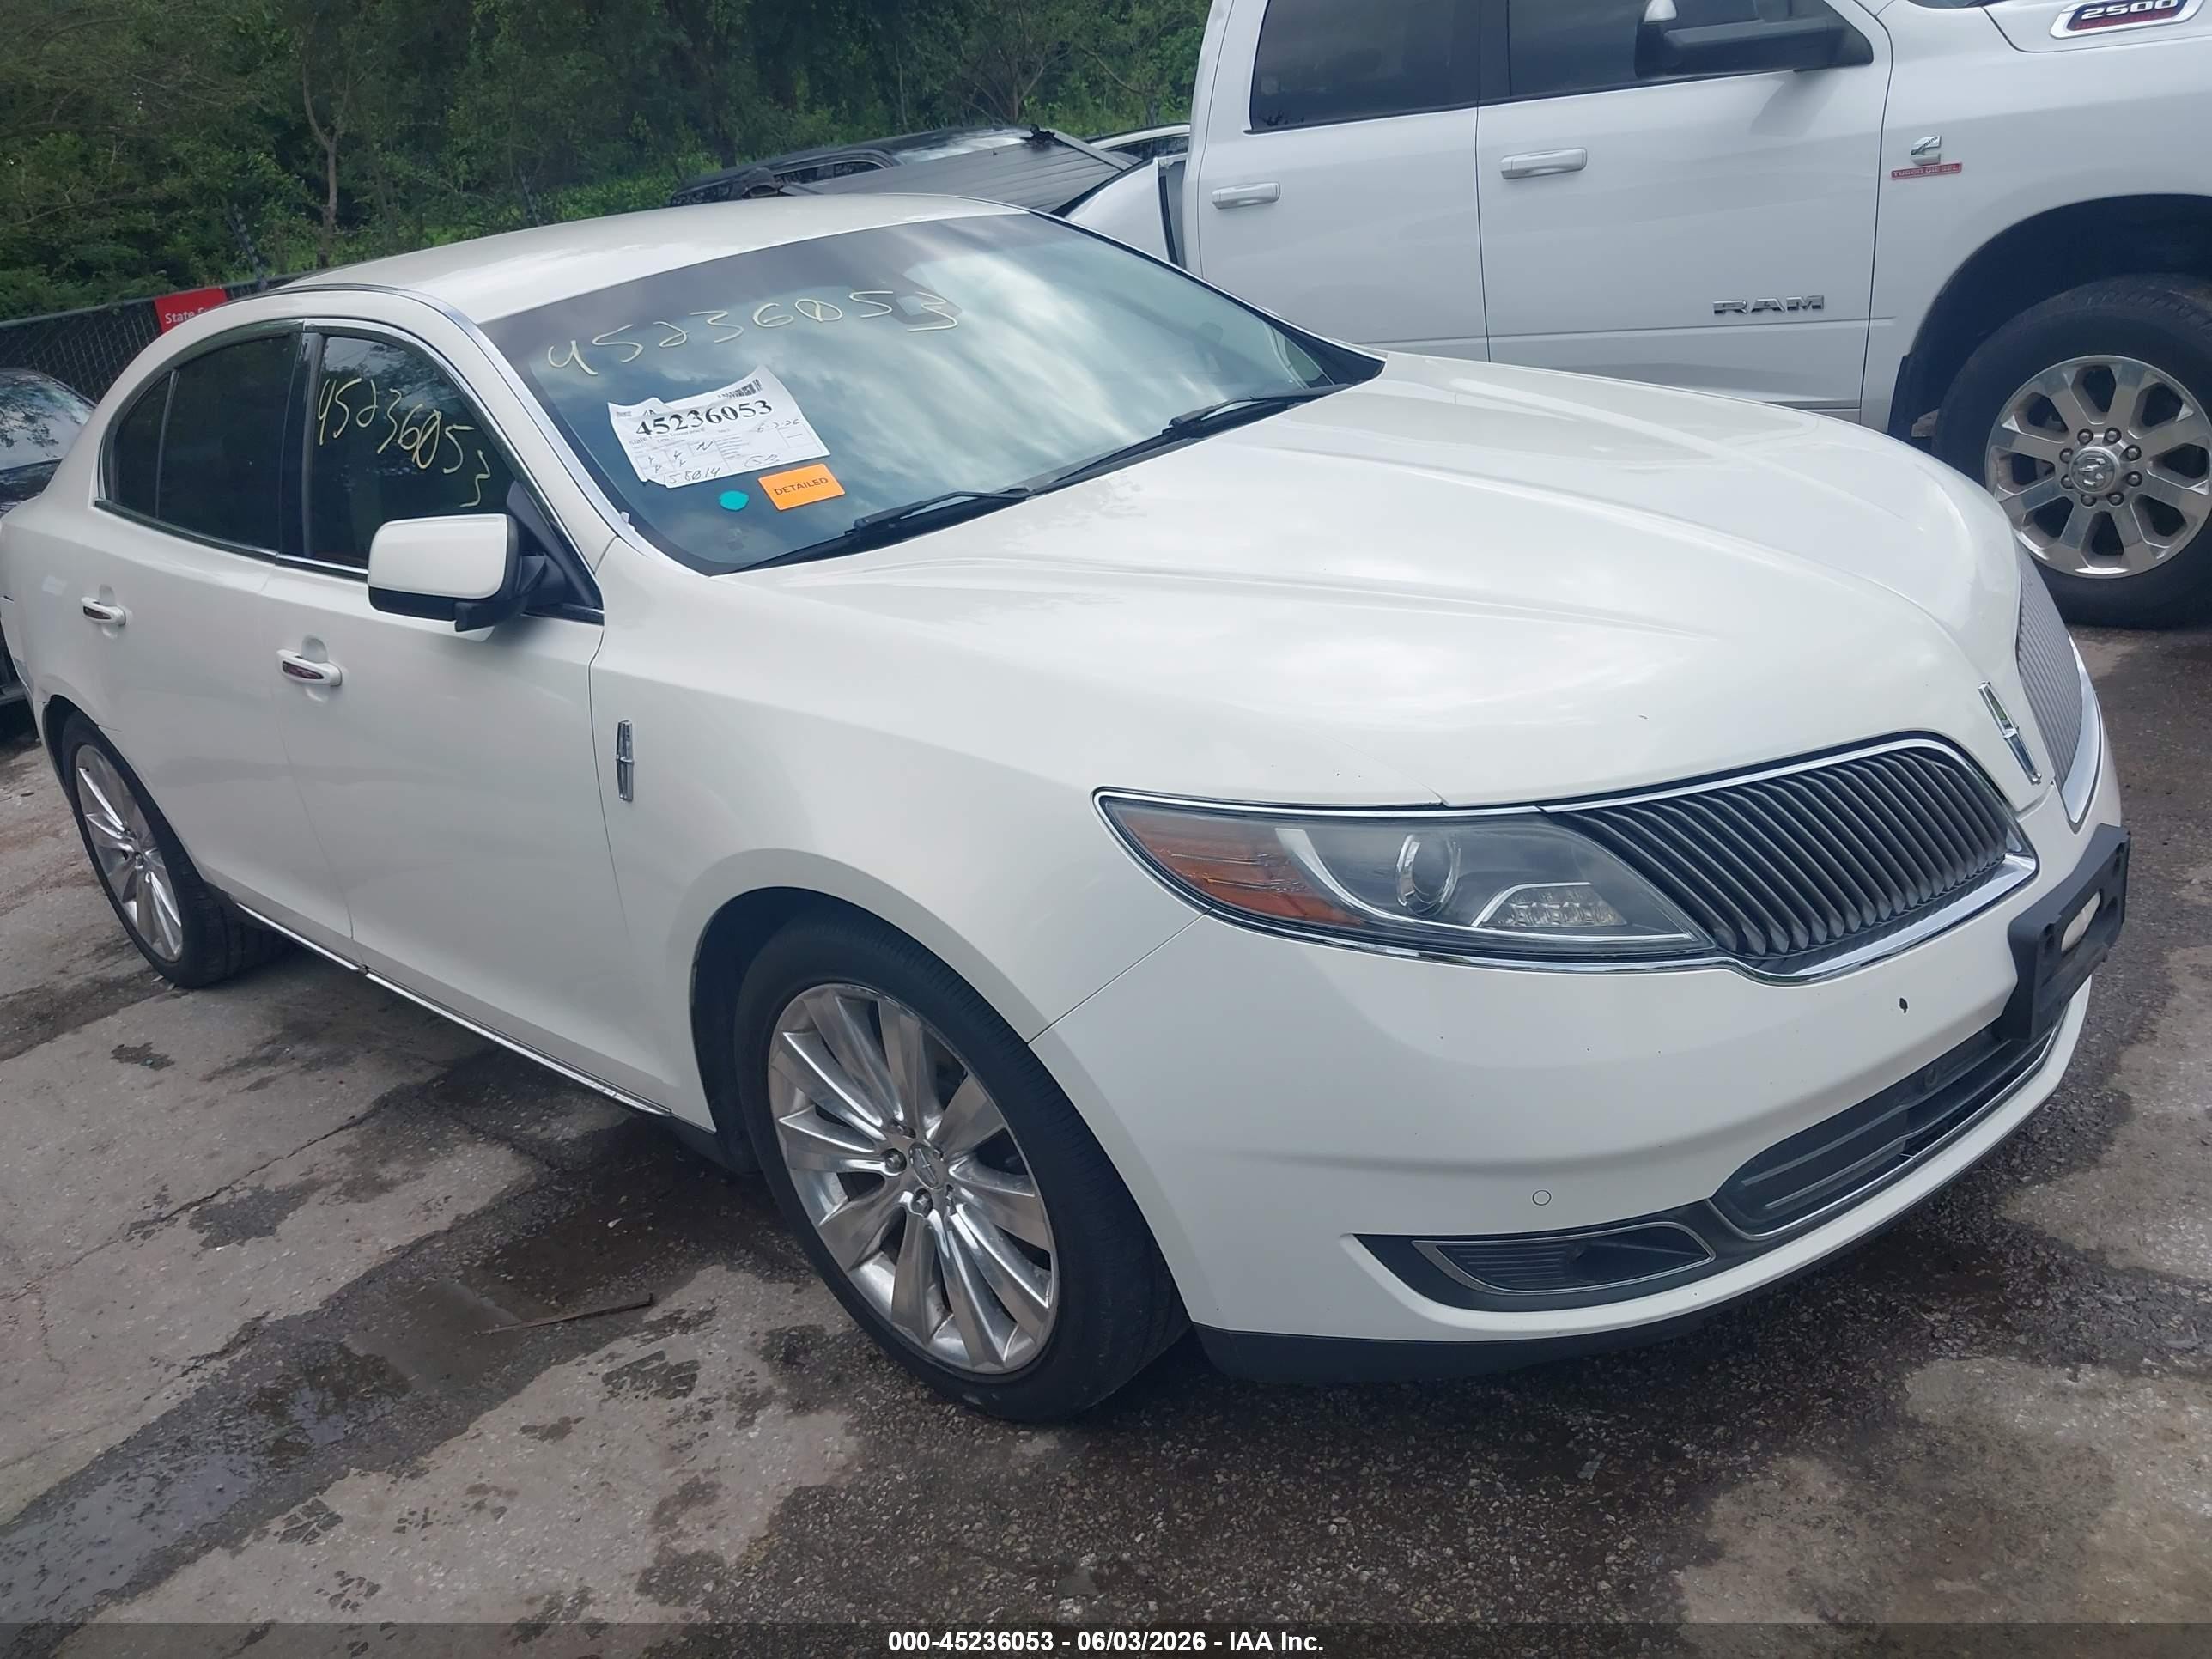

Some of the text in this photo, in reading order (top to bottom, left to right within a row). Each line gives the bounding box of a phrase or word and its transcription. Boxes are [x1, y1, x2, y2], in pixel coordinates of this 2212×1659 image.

[2081, 0, 2179, 20] 2500
[1713, 295, 1825, 315] RAM
[547, 290, 958, 376] 45236053
[635, 399, 773, 436] 45236053
[318, 377, 492, 507] 45236053
[774, 477, 830, 496] DETAILED
